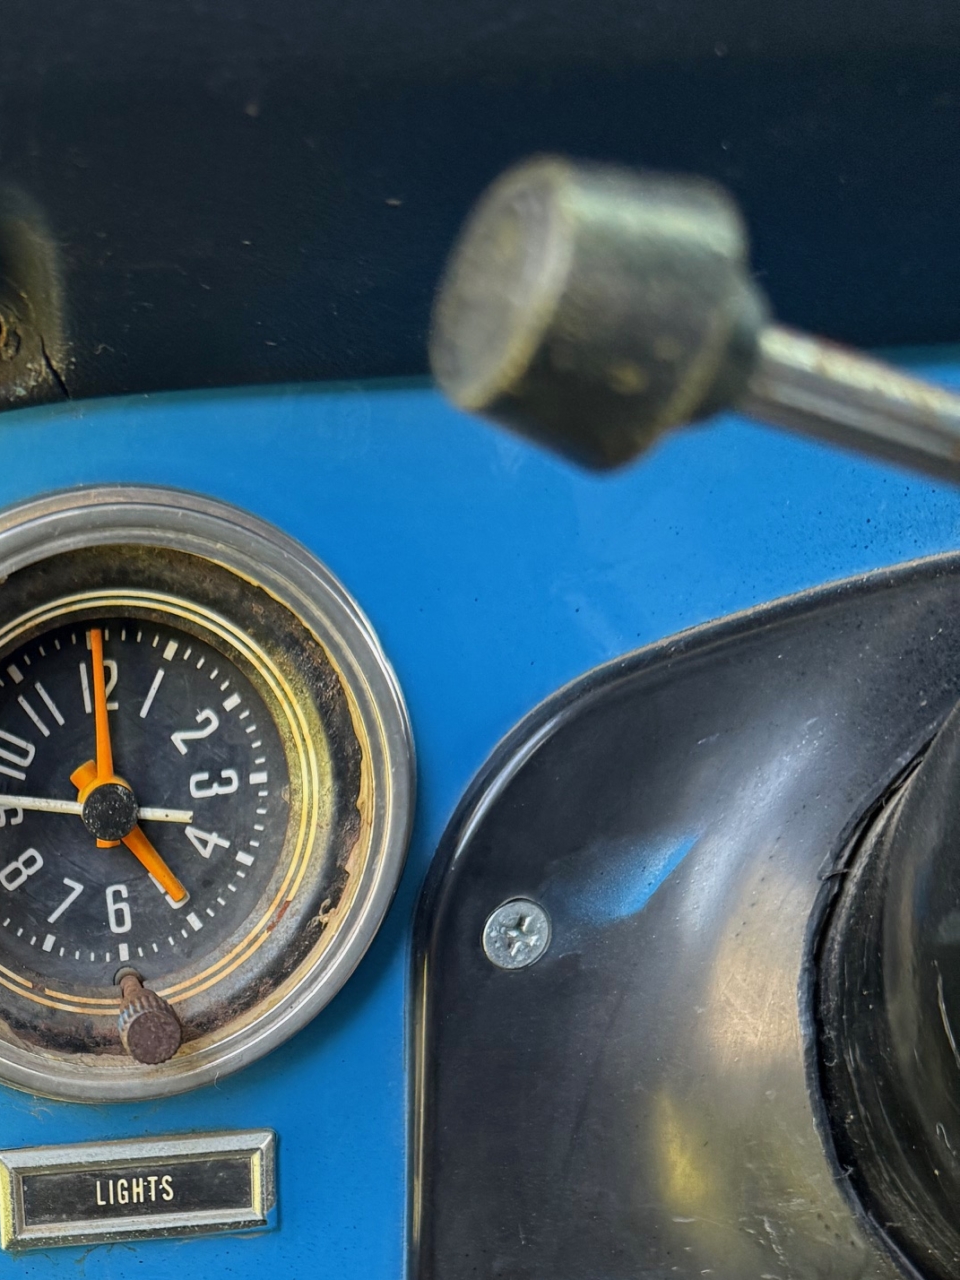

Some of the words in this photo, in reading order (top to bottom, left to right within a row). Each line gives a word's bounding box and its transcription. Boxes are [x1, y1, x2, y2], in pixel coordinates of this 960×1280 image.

[17, 681, 65, 737] 11
[140, 668, 165, 719] 1
[170, 707, 220, 755] 2
[189, 769, 239, 799] 3
[184, 825, 231, 859] 4
[47, 878, 84, 923] 7
[105, 884, 132, 934] 6
[96, 1175, 174, 1206] LIGHTS
